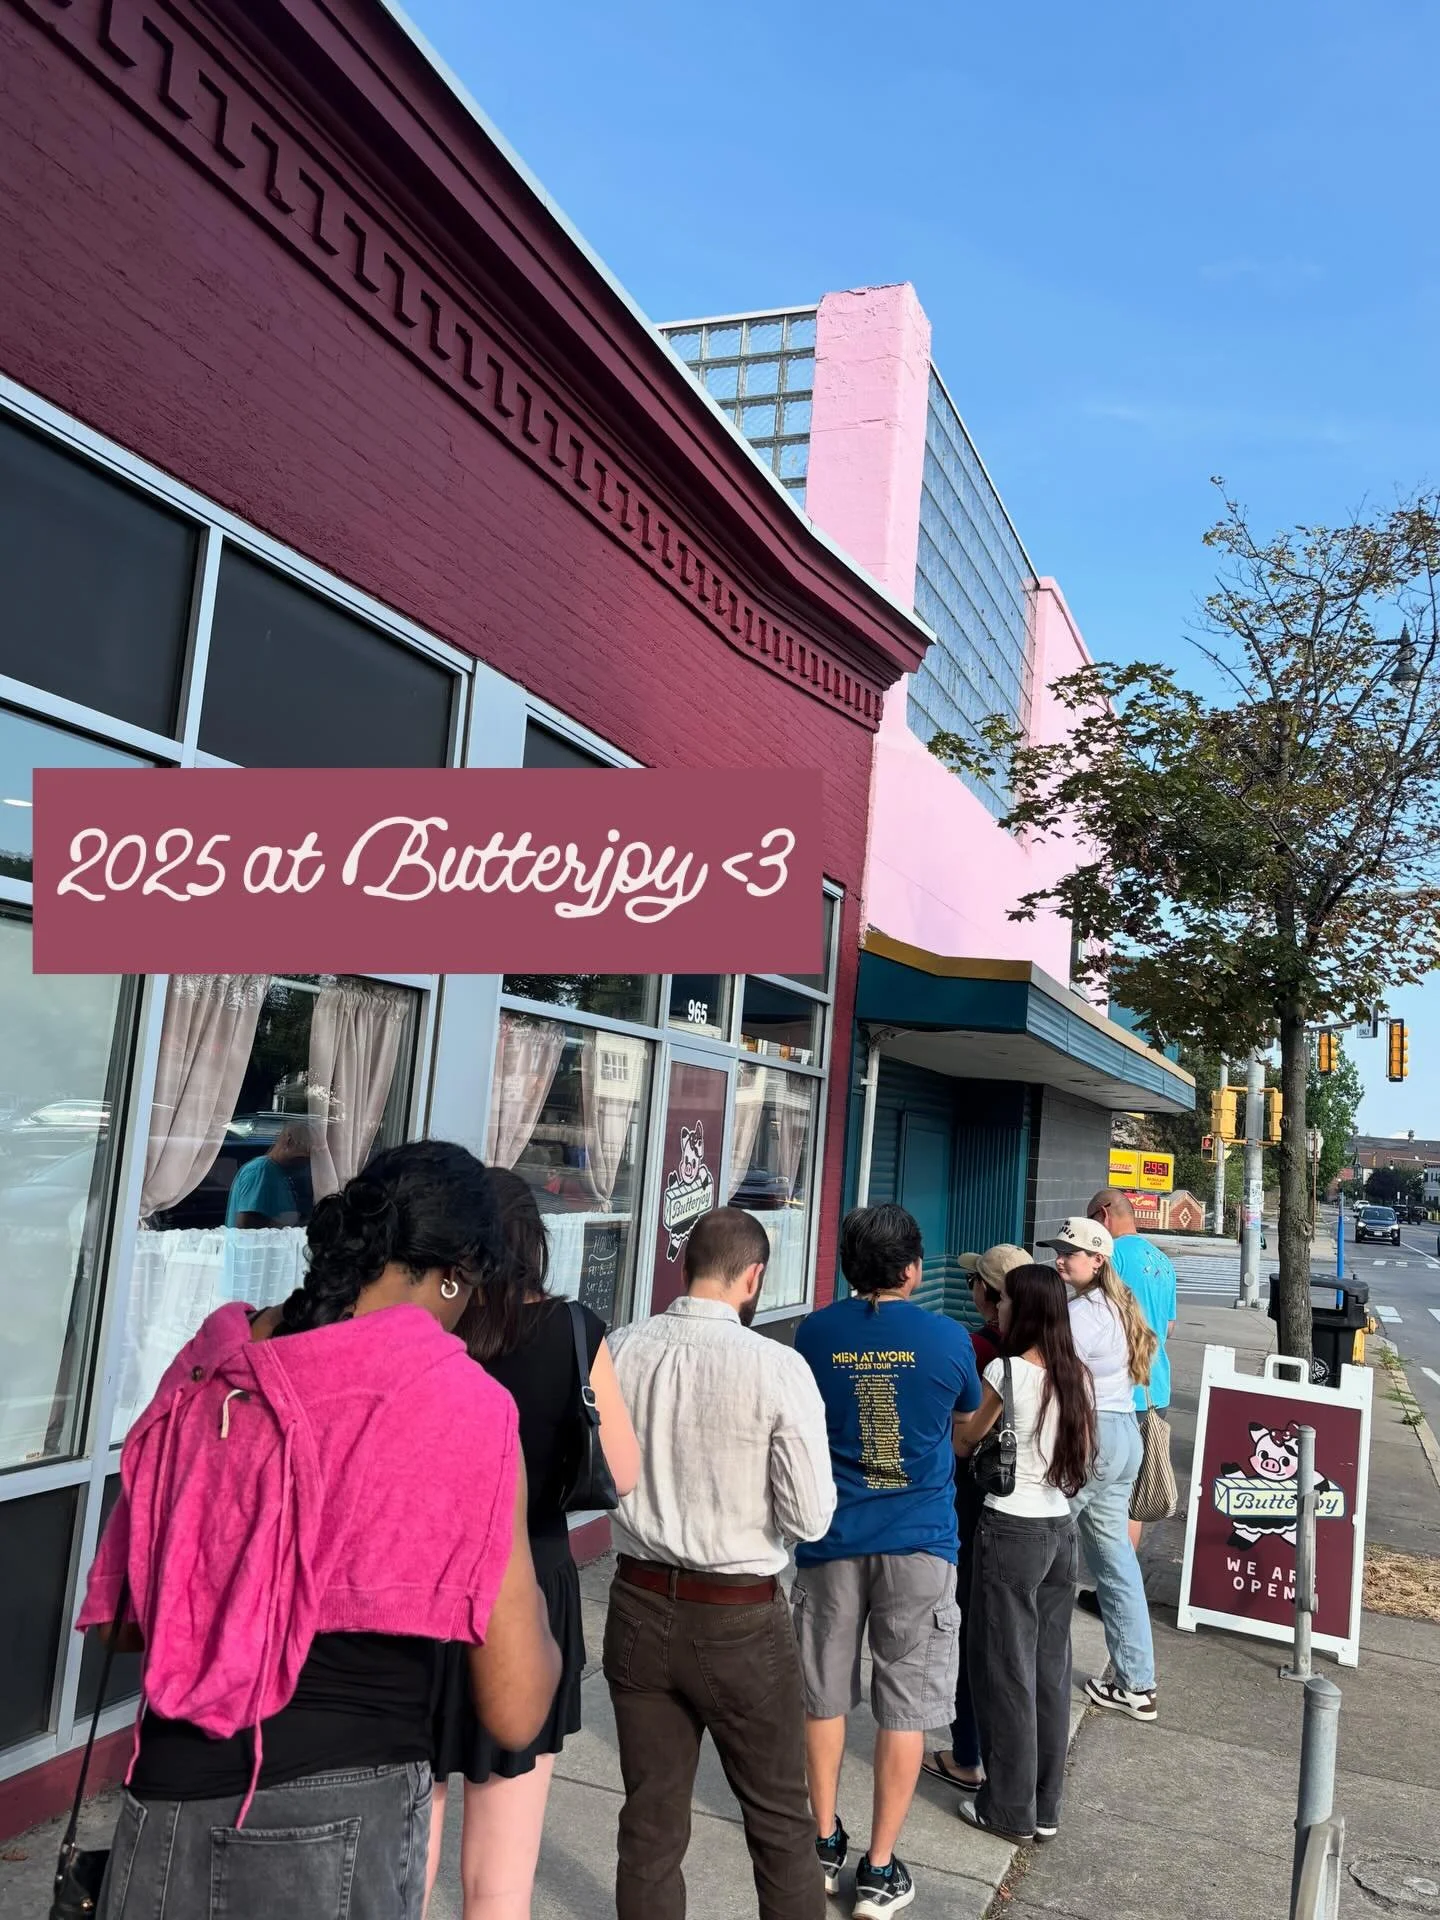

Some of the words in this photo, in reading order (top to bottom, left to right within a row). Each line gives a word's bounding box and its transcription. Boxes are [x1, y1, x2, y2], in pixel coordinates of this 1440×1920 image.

[688, 999, 708, 1025] 965
[672, 1191, 711, 1219] Butterjoy
[832, 1351, 858, 1364] MEN
[861, 1351, 875, 1363] AT
[876, 1351, 915, 1363] WORK
[1227, 1557, 1257, 1576] WE
[1233, 1576, 1296, 1600] OPEN
